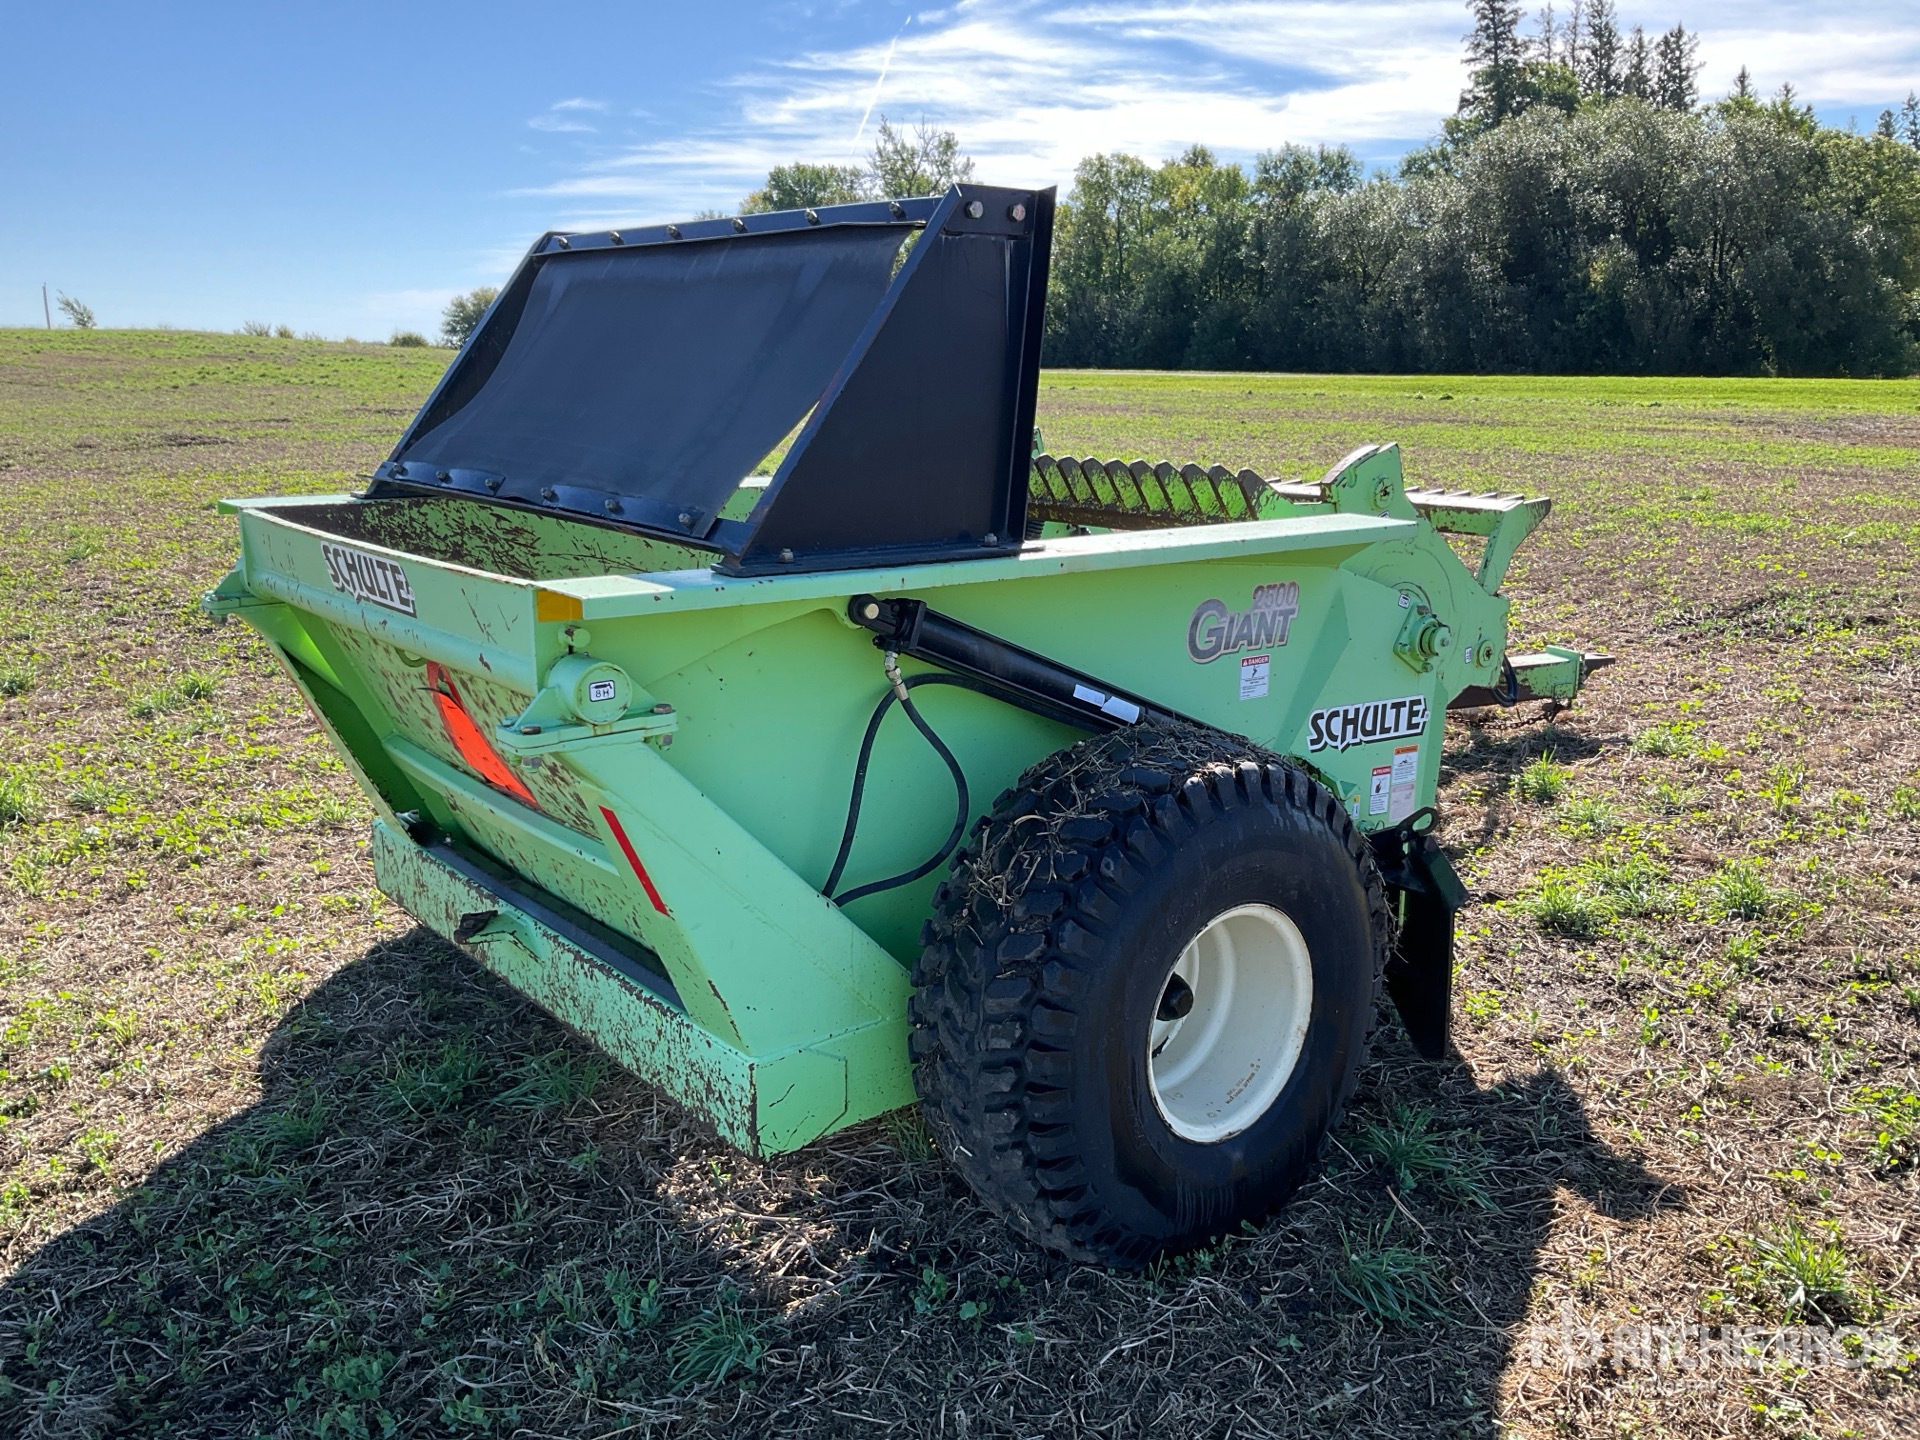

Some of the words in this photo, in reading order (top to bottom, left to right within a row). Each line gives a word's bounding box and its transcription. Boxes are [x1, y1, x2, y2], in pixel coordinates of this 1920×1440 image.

[321, 543, 413, 611] SCHULTE
[1253, 582, 1299, 609] 2500
[1248, 656, 1269, 665] DANGER
[1308, 698, 1423, 747] SCHULTE
